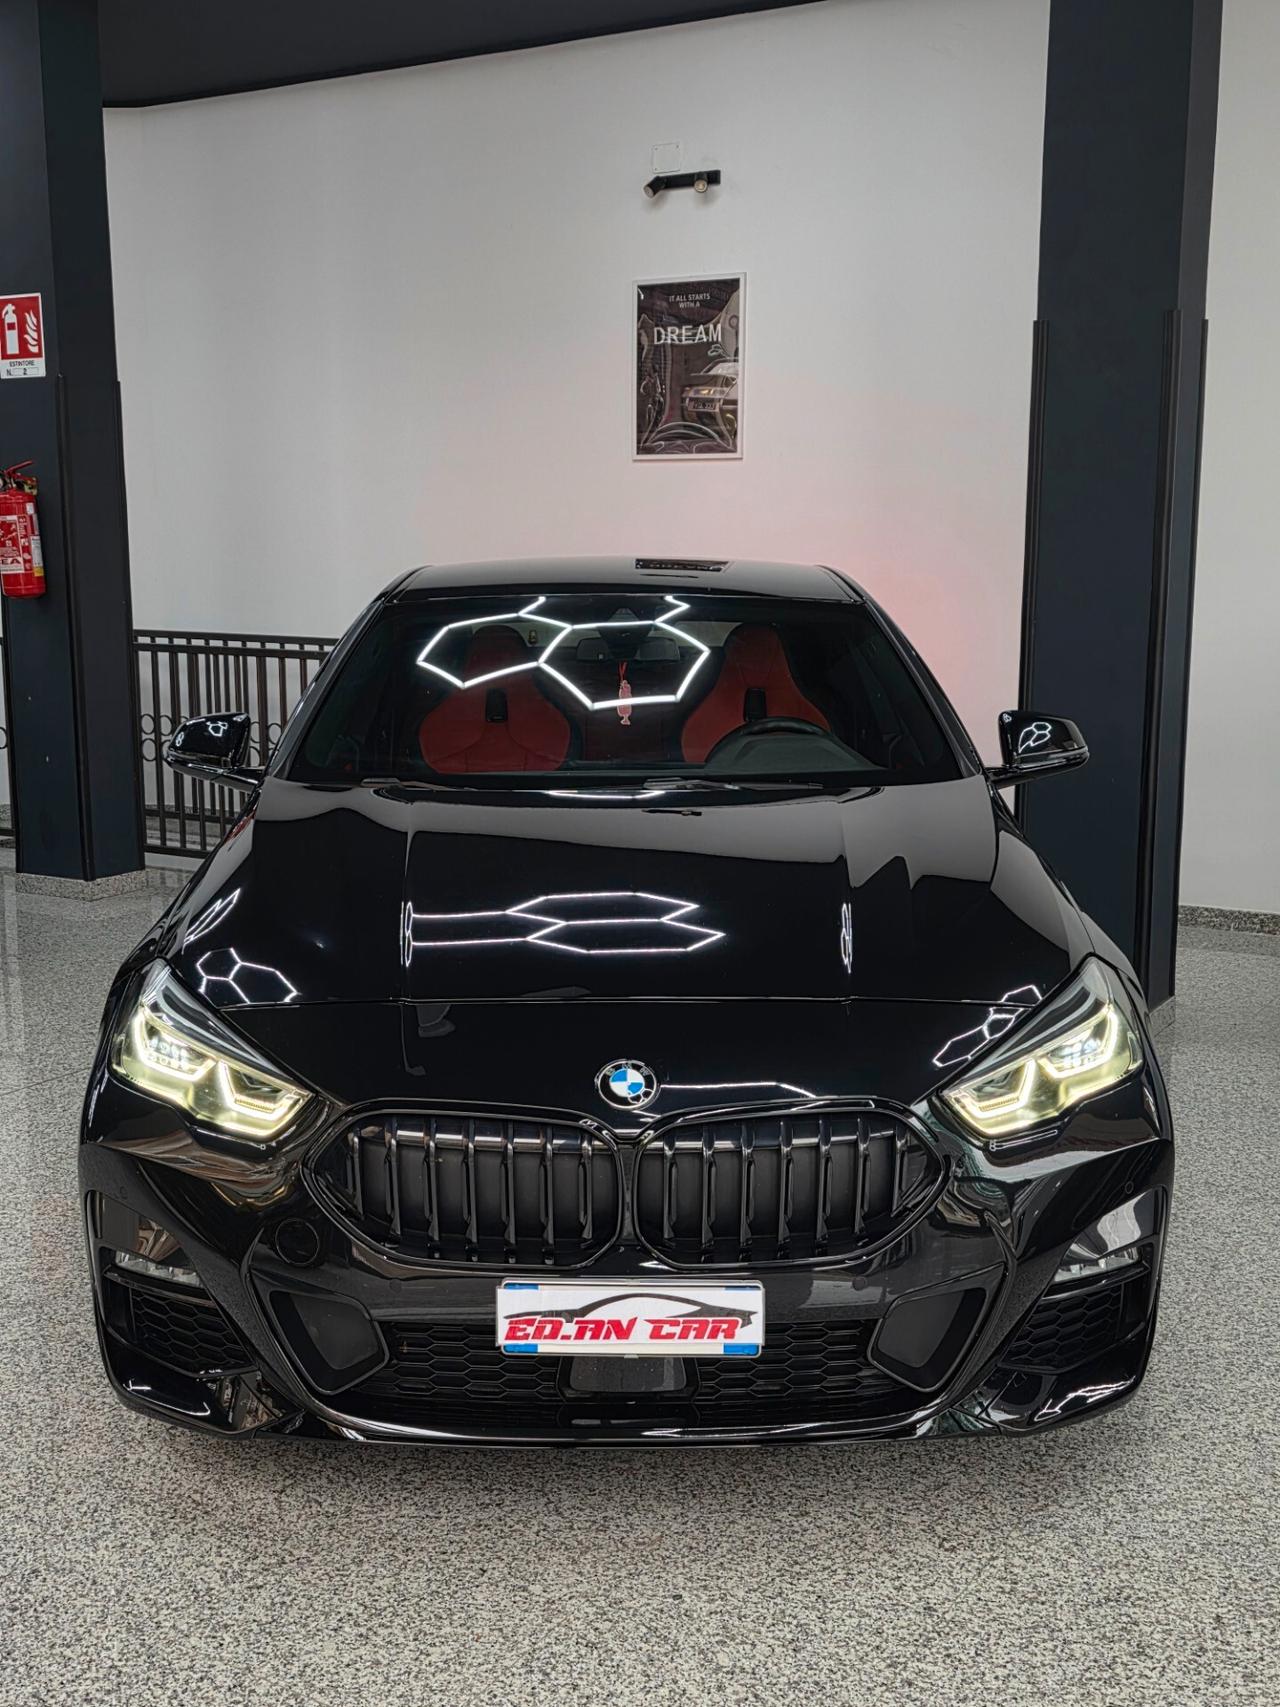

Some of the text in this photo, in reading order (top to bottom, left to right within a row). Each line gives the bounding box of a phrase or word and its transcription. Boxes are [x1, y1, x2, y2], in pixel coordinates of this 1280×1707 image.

[688, 293, 710, 301] STARTS
[653, 324, 722, 345] DREAM
[644, 1319, 742, 1340] CAR
